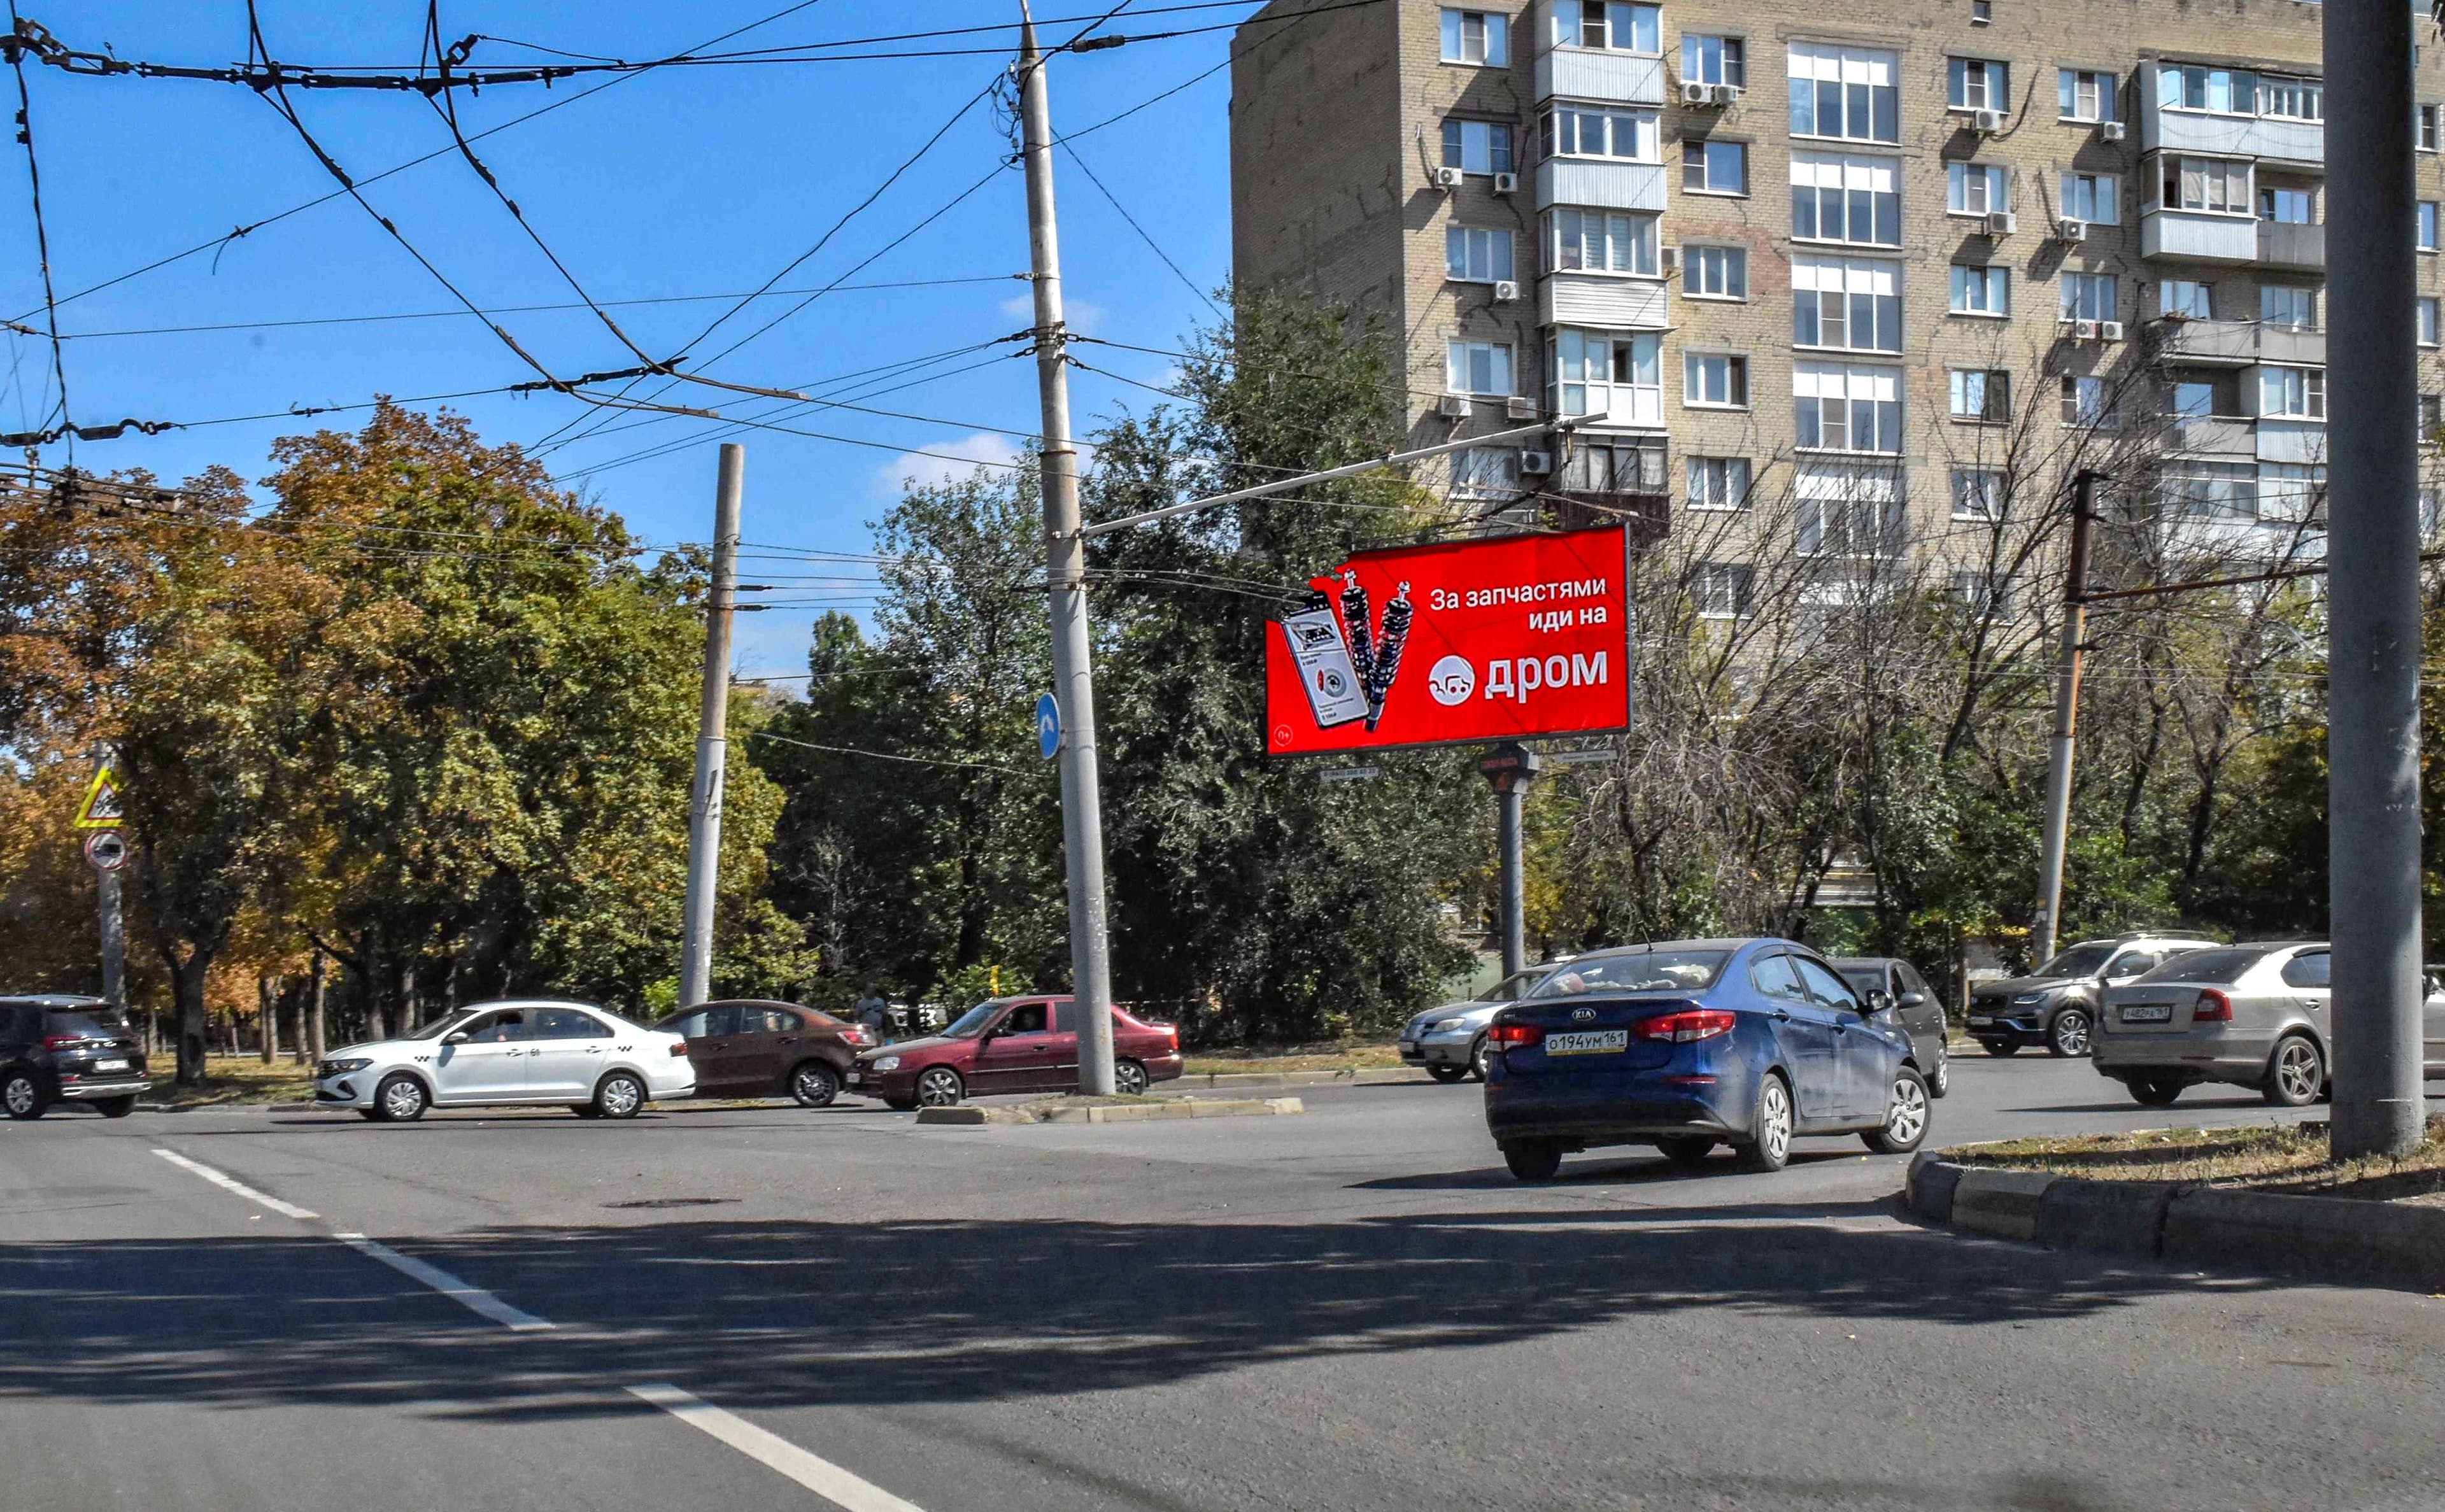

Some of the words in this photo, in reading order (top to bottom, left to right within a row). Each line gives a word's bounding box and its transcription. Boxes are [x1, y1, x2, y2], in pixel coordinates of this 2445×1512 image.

[1430, 588, 1459, 611] За
[1466, 578, 1606, 607] запчастями
[1529, 609, 1573, 633] иди
[1579, 605, 1607, 625] на
[1484, 651, 1608, 704] дром
[1575, 1010, 1592, 1019] KIA
[1604, 1032, 1624, 1043] 161
